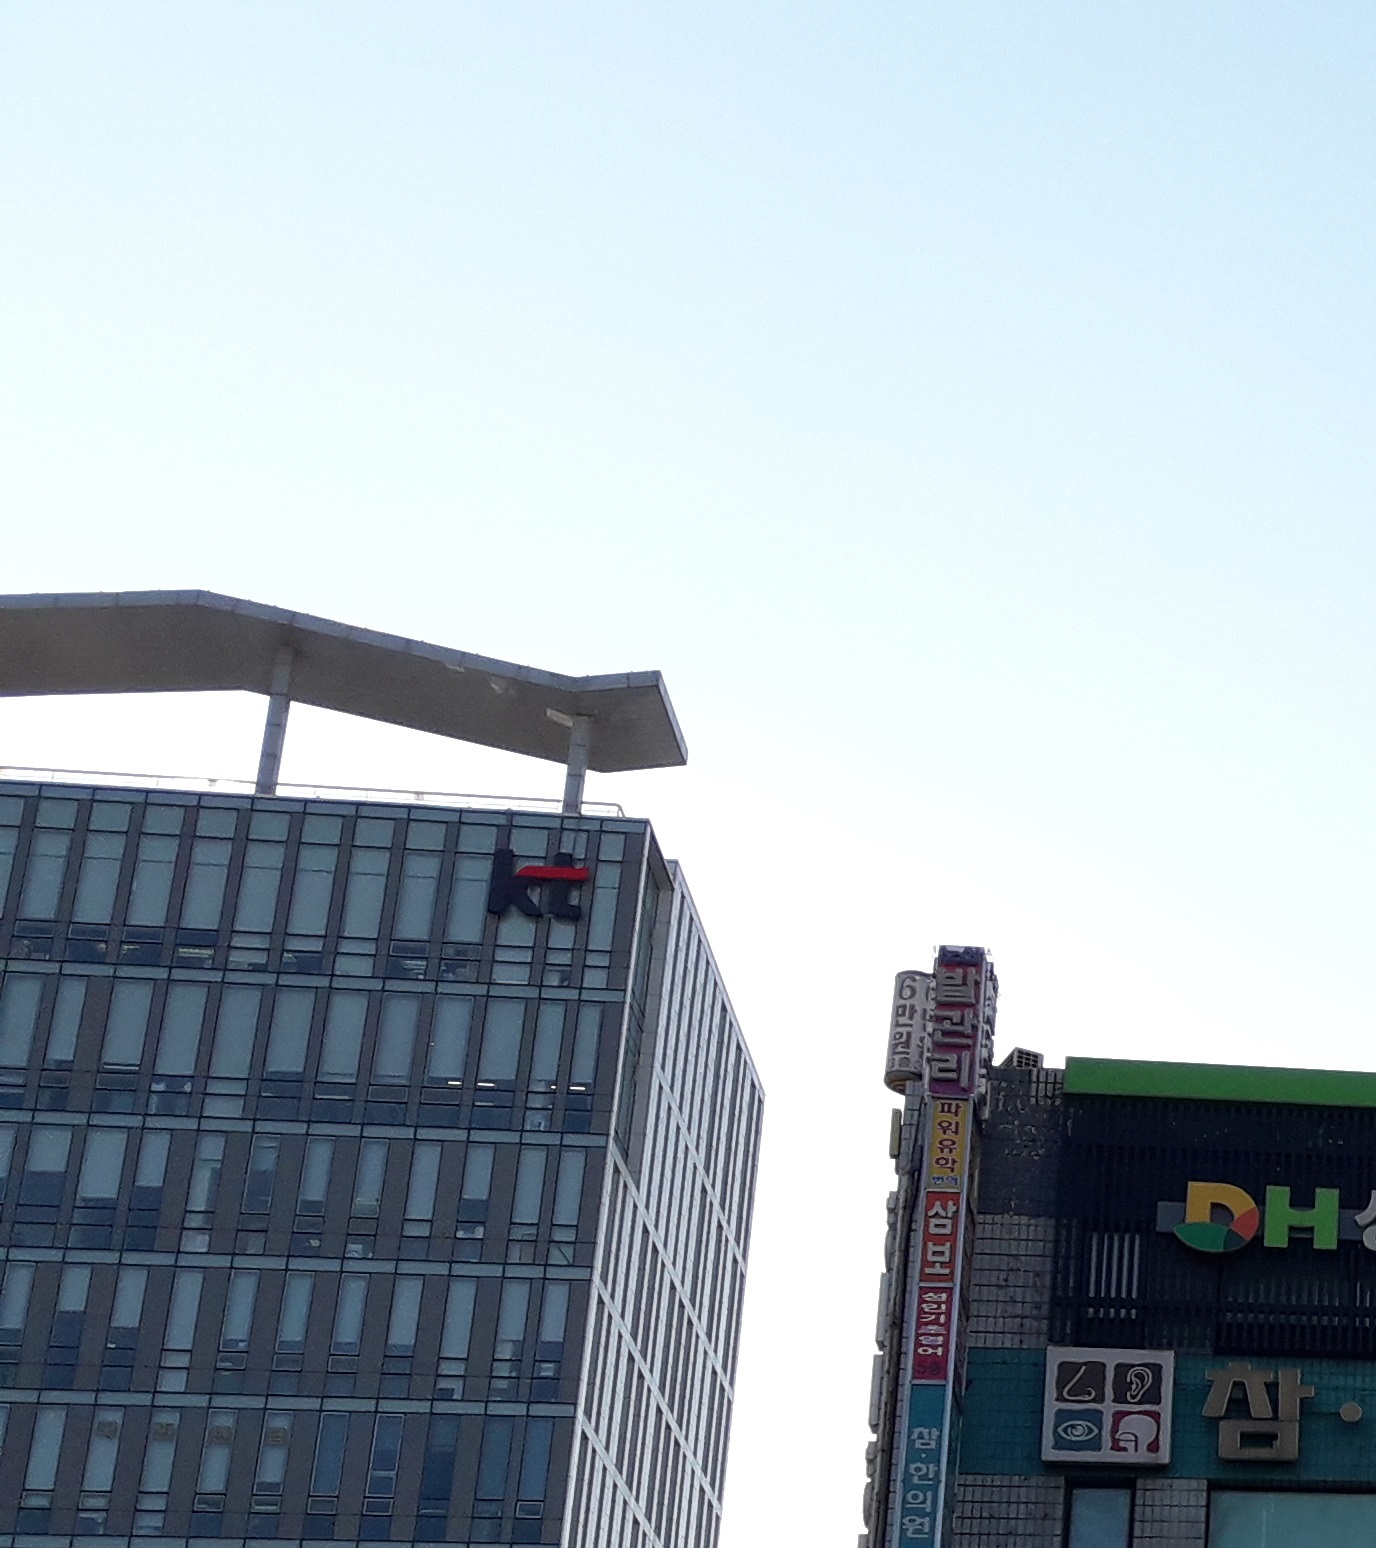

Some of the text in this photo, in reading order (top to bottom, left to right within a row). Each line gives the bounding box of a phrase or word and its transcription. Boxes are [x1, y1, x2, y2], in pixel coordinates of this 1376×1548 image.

[934, 1101, 963, 1174] 파워유학
[923, 1199, 958, 1277] 삼보
[1172, 1180, 1341, 1253] DH
